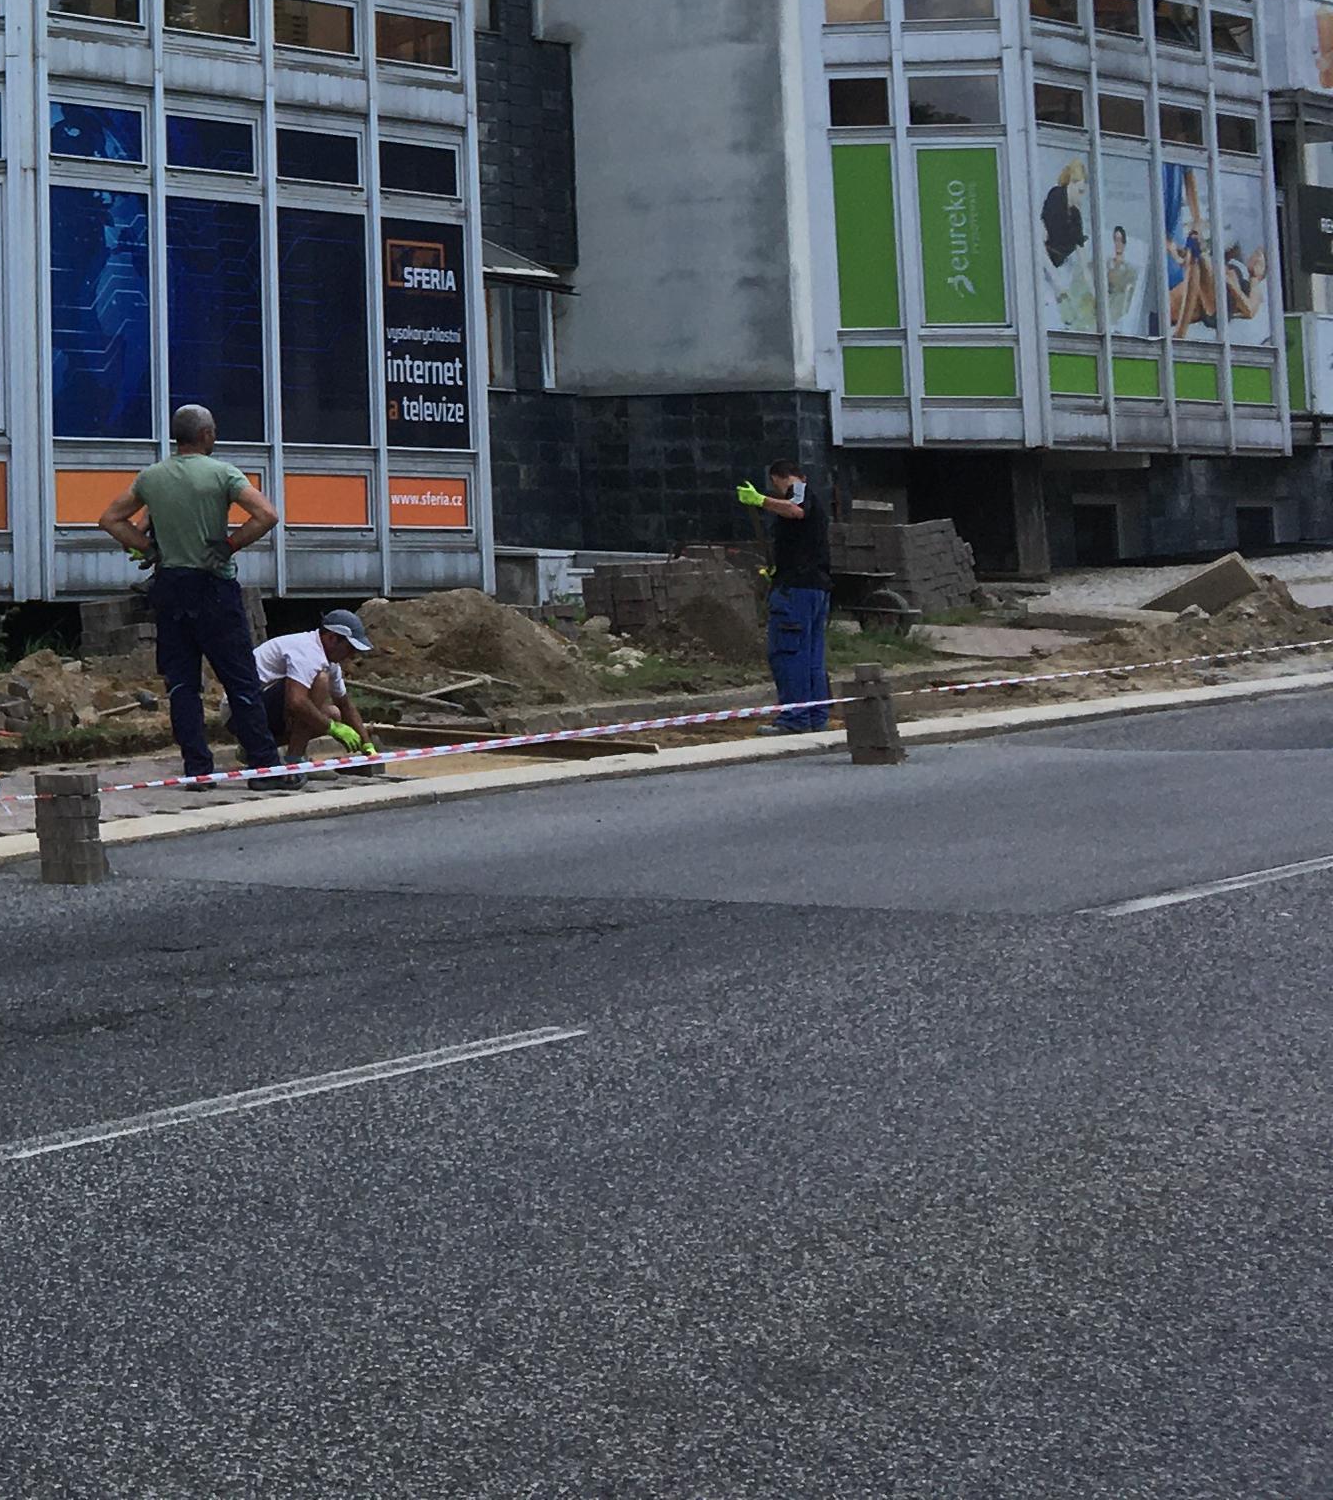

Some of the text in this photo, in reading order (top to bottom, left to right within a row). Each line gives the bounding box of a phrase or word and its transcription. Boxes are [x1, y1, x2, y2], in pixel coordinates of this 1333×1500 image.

[942, 180, 970, 272] eureko
[403, 266, 456, 291] SFERIA
[387, 351, 464, 386] internet
[389, 396, 464, 423] a televize
[390, 491, 463, 507] www.sferia.cz
